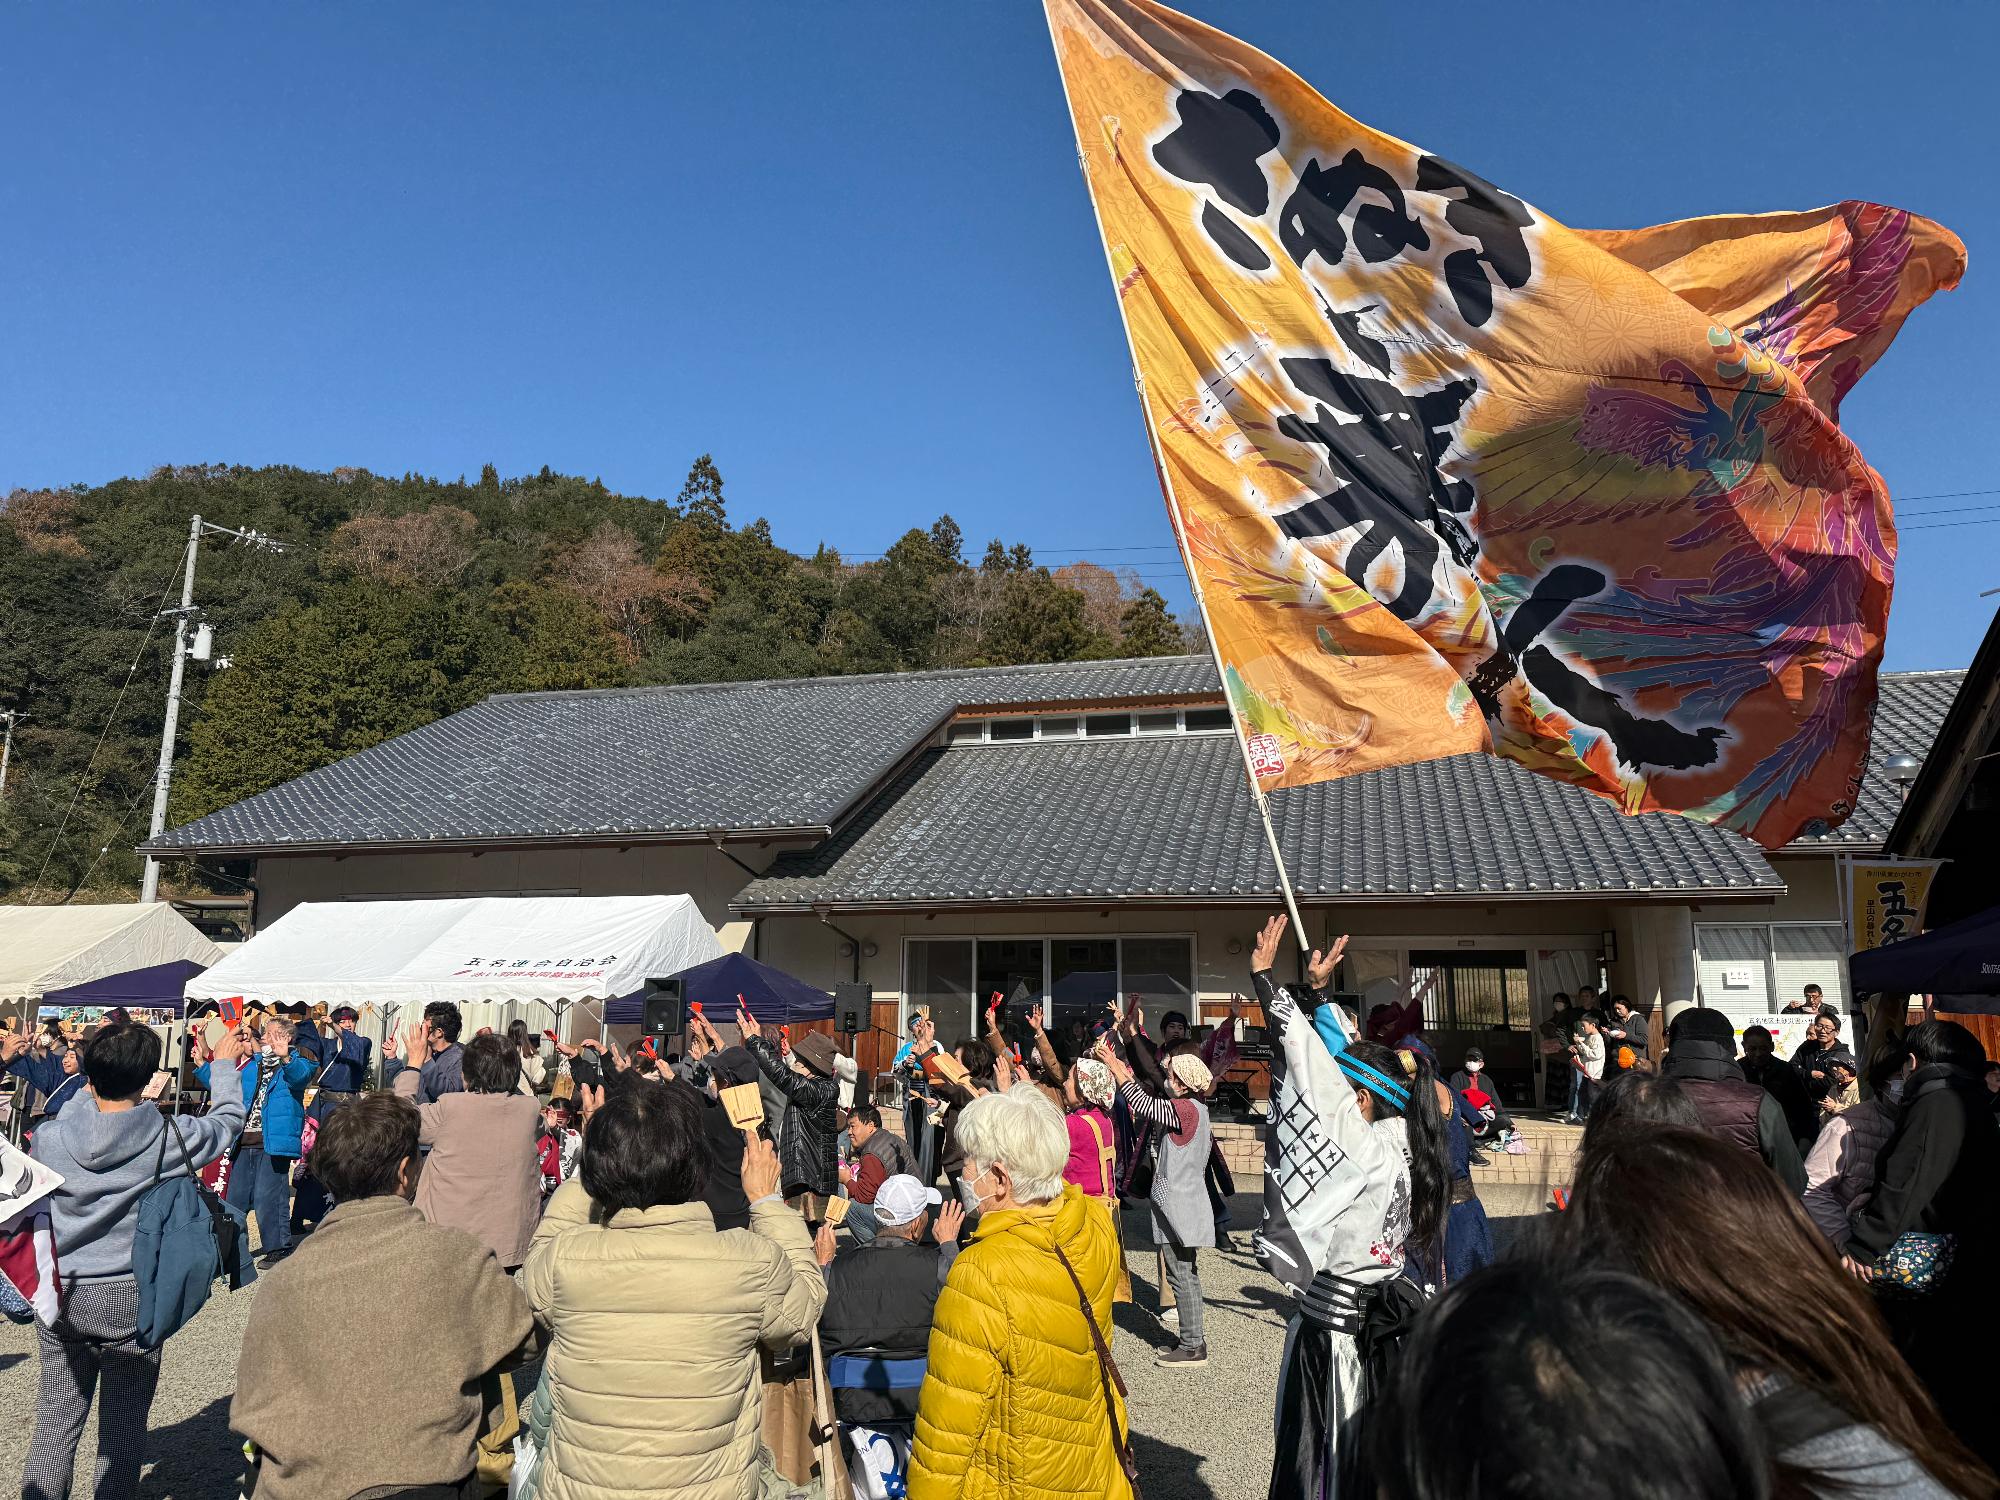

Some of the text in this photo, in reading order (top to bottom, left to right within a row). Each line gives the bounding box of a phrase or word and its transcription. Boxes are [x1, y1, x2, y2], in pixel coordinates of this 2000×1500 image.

[464, 955, 618, 968] 五名連合自治会
